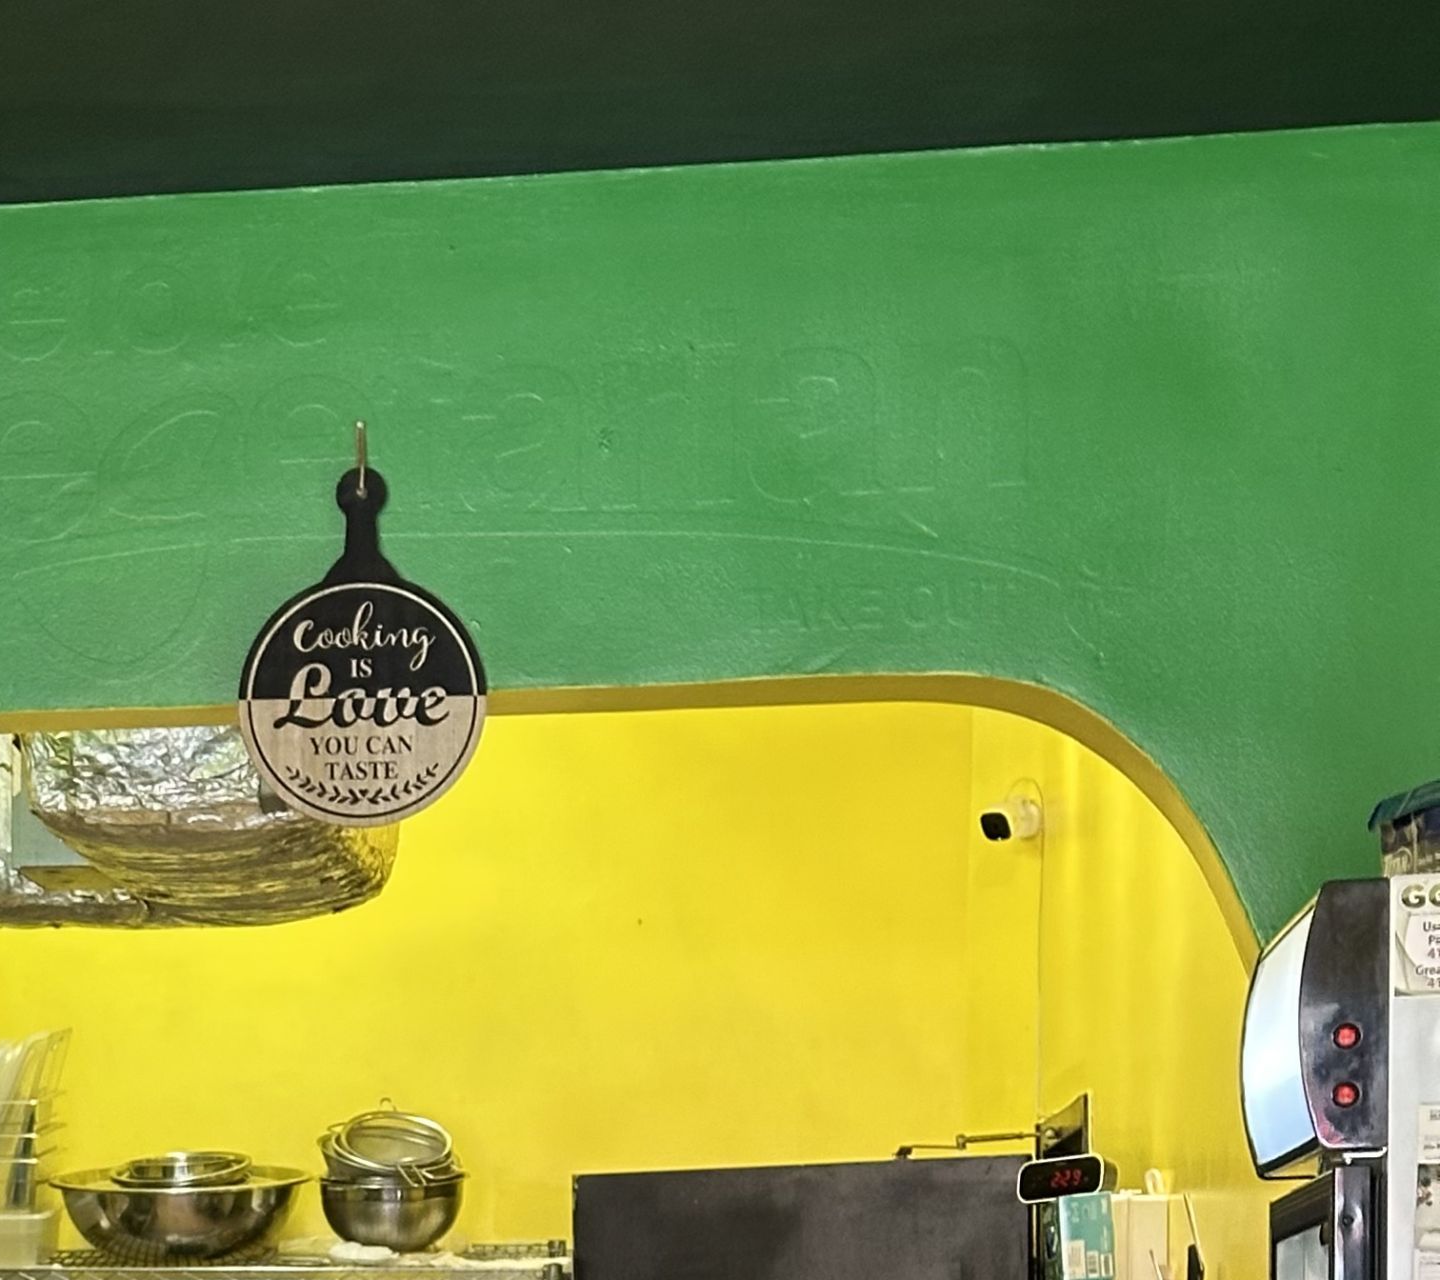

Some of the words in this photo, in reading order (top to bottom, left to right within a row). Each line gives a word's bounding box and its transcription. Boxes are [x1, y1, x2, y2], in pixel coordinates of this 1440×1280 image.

[293, 601, 436, 671] Cooking
[350, 658, 373, 678] IS
[273, 662, 450, 729] Love
[310, 736, 358, 755] YOU
[366, 735, 412, 754] CAN
[325, 761, 399, 781] TASTE
